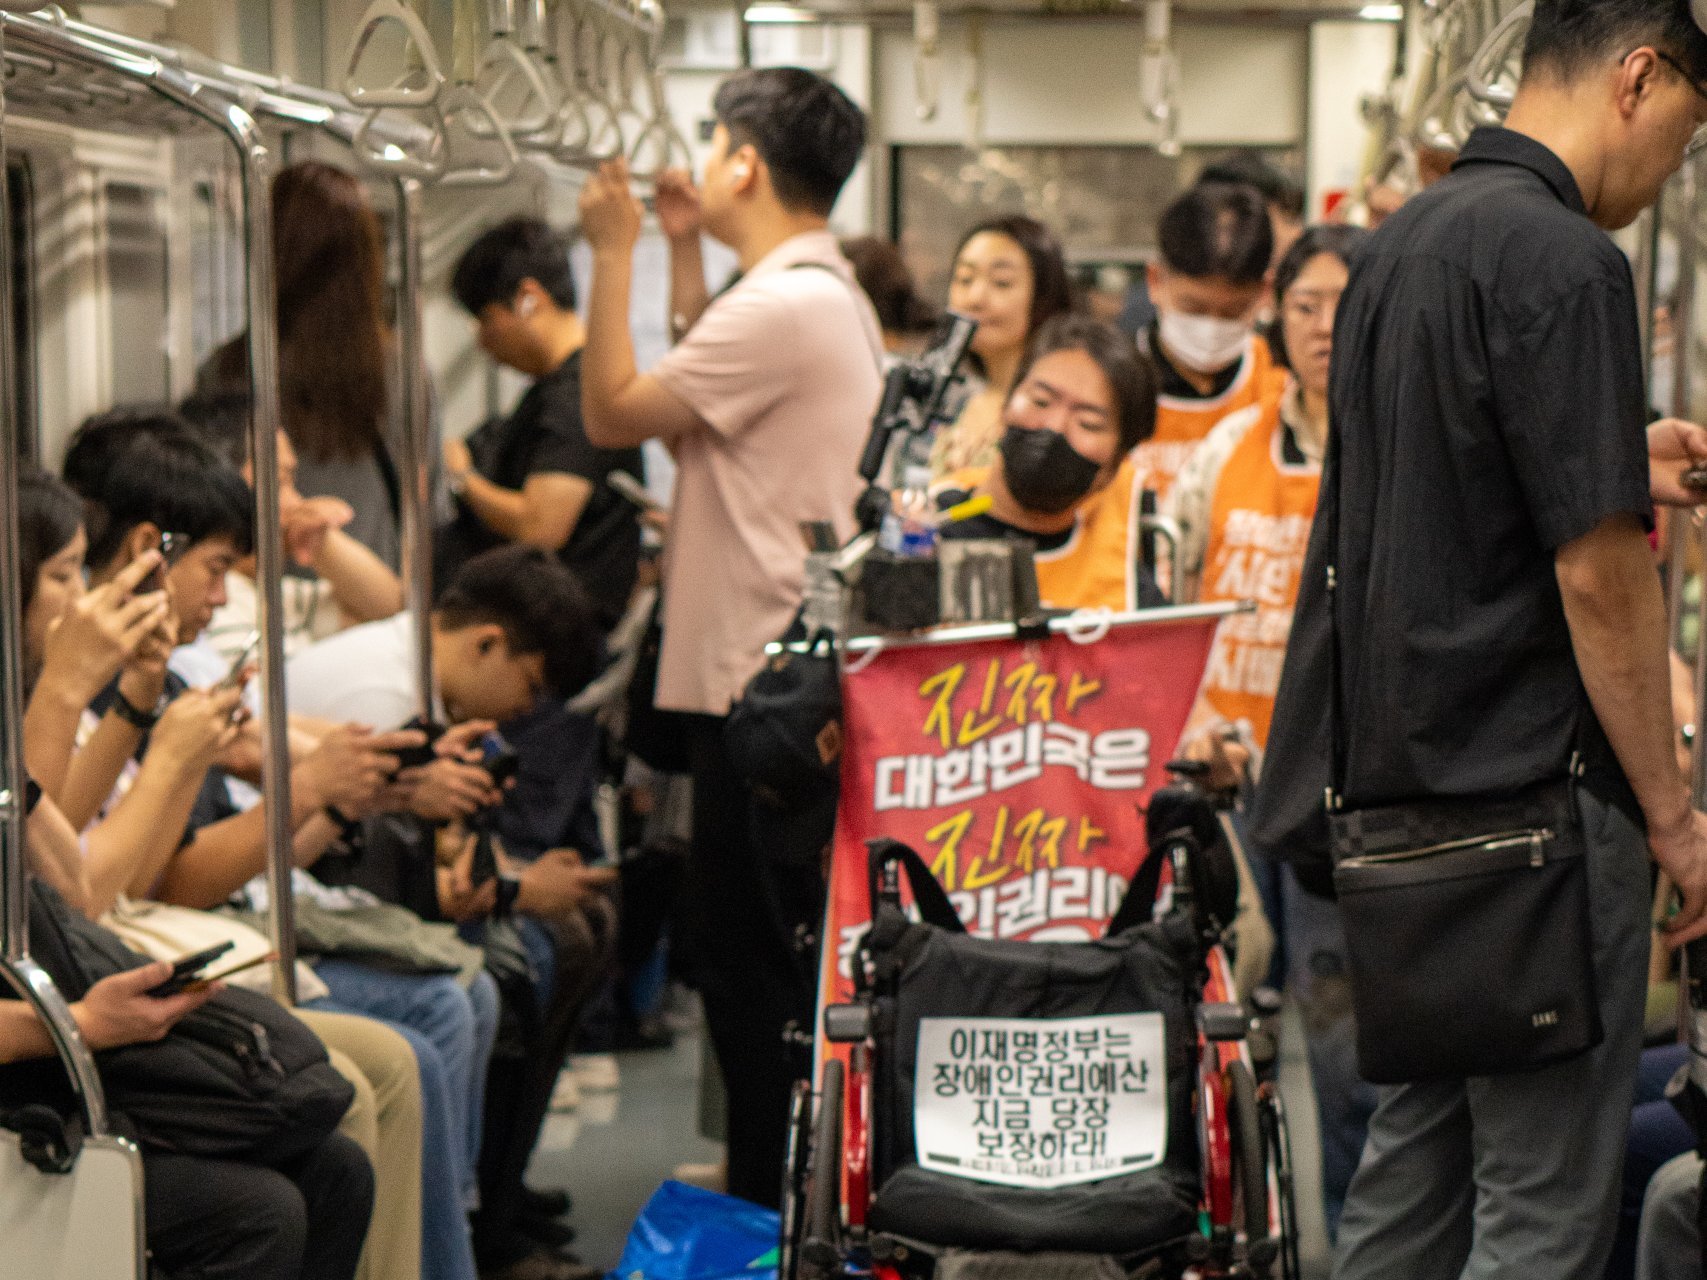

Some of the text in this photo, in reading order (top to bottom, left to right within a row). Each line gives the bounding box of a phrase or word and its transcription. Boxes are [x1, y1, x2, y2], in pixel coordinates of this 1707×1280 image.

[919, 658, 1101, 747] 진짜
[874, 721, 1150, 812] 대한민국은
[924, 805, 1105, 891] 진짜
[949, 1027, 1131, 1064] 이재명정부는
[933, 1060, 1149, 1097] 장애인권리예산
[972, 1097, 1110, 1131] 지금 당장
[977, 1131, 1106, 1162] 보장하라!
